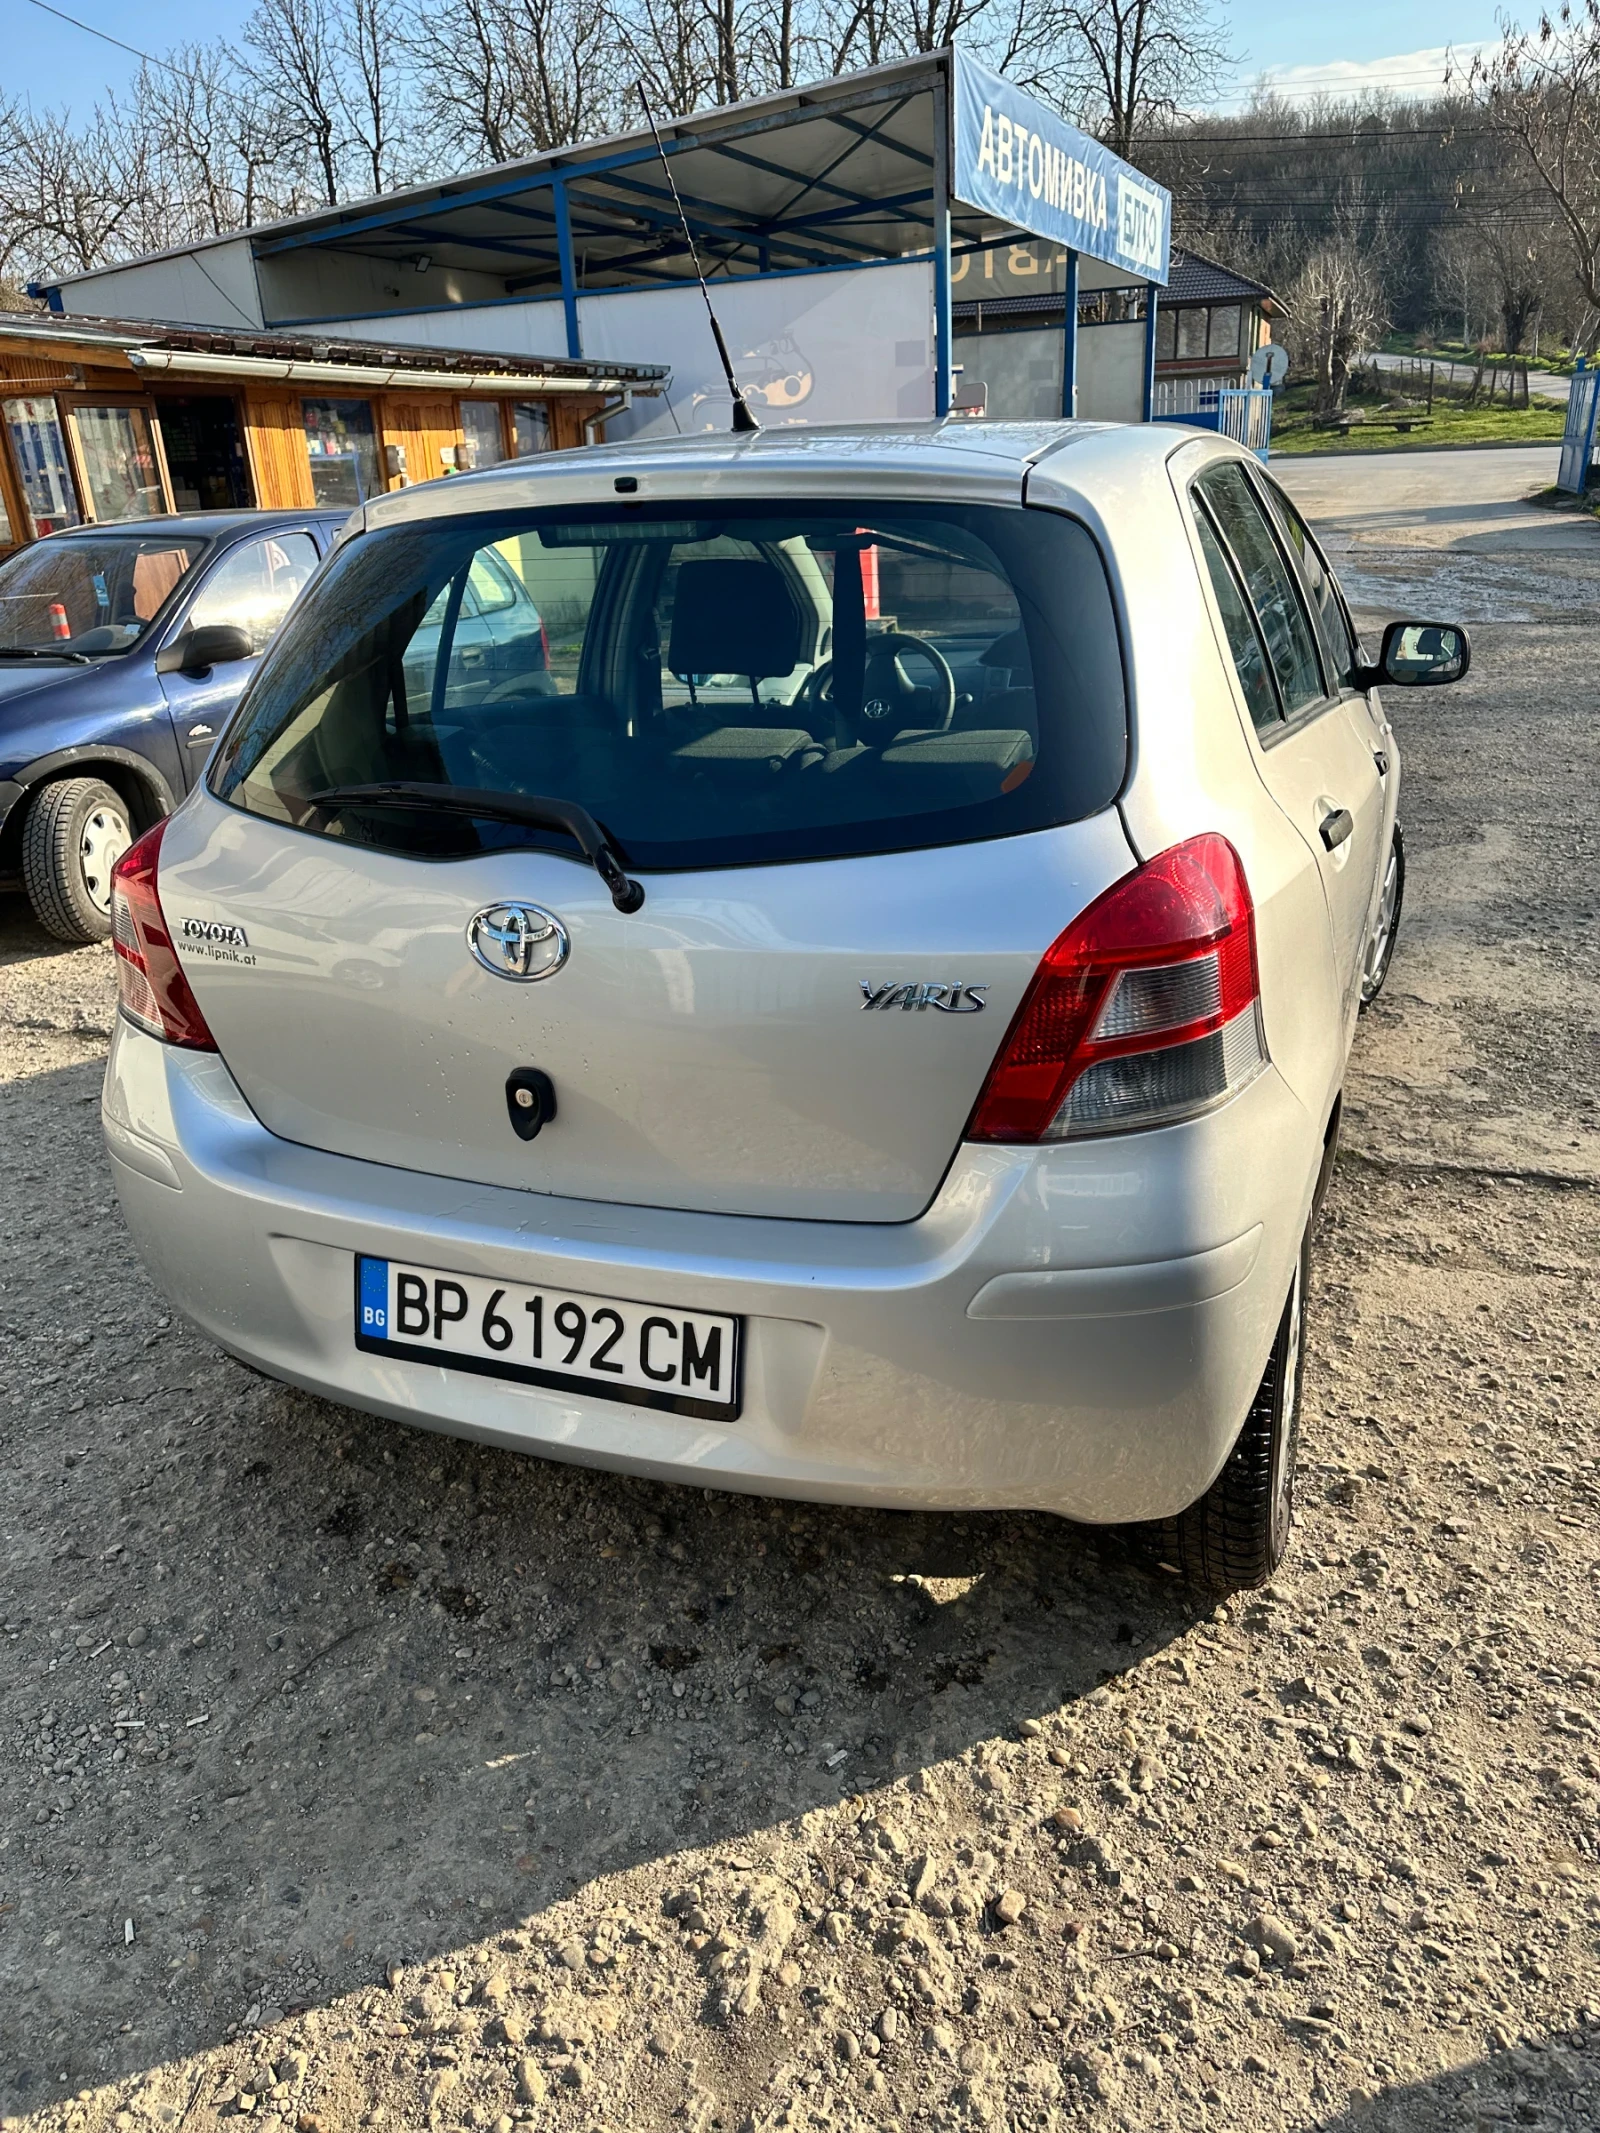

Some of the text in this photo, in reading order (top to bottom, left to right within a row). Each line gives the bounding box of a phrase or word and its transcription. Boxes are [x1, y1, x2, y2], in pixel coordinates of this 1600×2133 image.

[977, 104, 1108, 232] АВТОМИВКА
[179, 917, 248, 947] TOYOTA
[178, 941, 257, 965] www.lipnik.at
[364, 1306, 385, 1327] BG
[397, 1272, 721, 1391] BP 6192 CM
